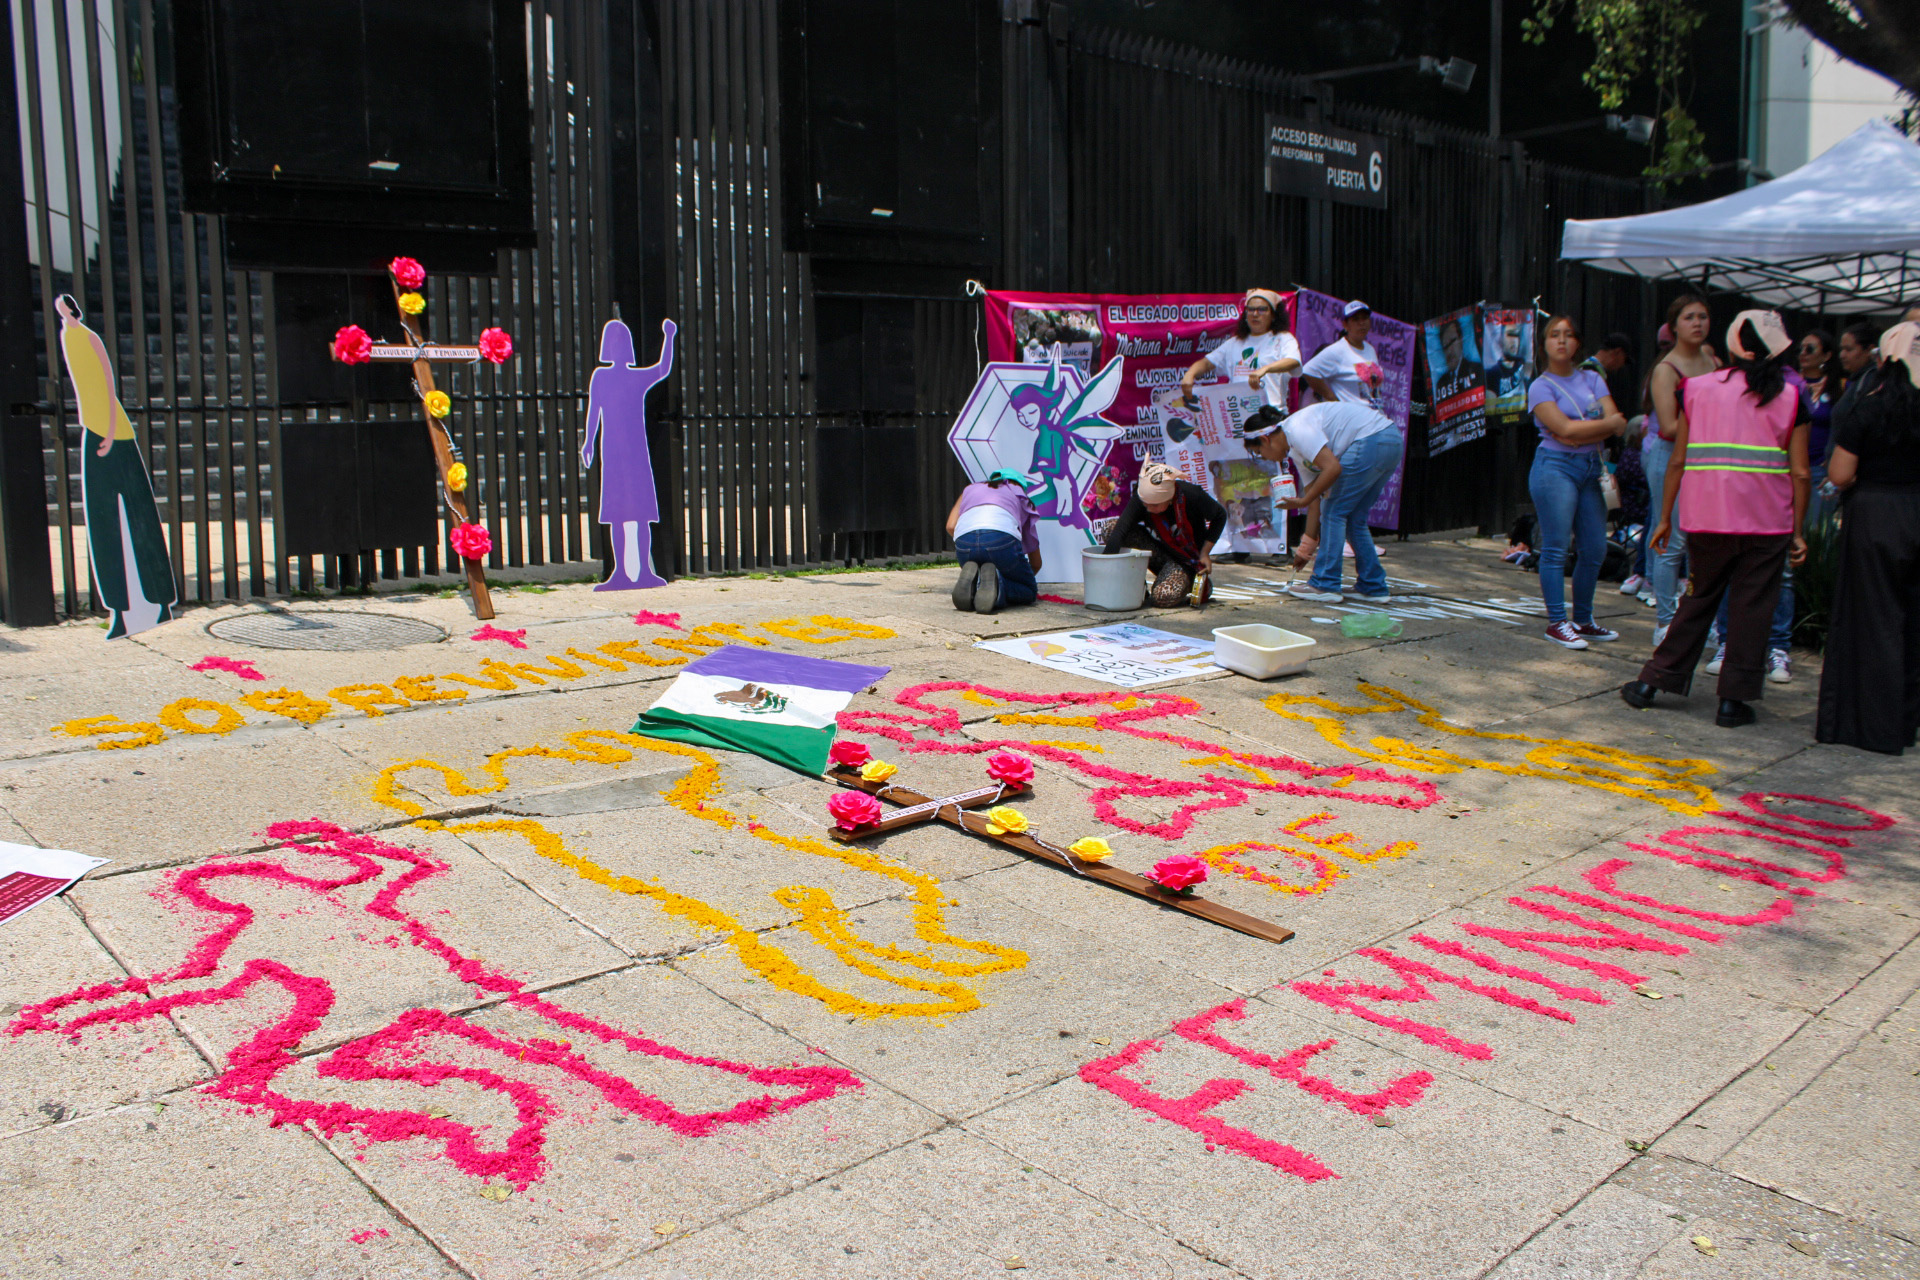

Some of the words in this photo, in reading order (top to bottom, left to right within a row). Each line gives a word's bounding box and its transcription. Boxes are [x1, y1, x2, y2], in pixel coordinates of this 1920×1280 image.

[1271, 126, 1307, 145] ACCESO
[1308, 132, 1357, 156] ESCALINATAS
[1271, 146, 1282, 157] AV.
[1282, 147, 1314, 162] REFORMA
[1327, 166, 1365, 190] PUERTA
[1369, 150, 1382, 193] 6
[1109, 306, 1126, 321] EL
[1128, 305, 1178, 321] LEGADO
[1181, 305, 1206, 321] QUE
[1208, 304, 1239, 319] DEJO
[1306, 294, 1328, 316] SOY
[1116, 332, 1161, 358] Mariana
[1165, 331, 1192, 356] Lima
[1377, 342, 1407, 367] REYES
[1137, 371, 1149, 385] LA
[1150, 370, 1177, 384] JOVEN
[1436, 378, 1459, 401] JOSÉ
[1139, 408, 1150, 421] LA
[1219, 401, 1233, 439] Cuernavaca
[1226, 395, 1245, 440] Morelos
[1135, 444, 1146, 458] LA
[1179, 449, 1189, 461] es
[1196, 812, 1419, 896] DE
[1078, 792, 1897, 1183] FEMINICIDIO
